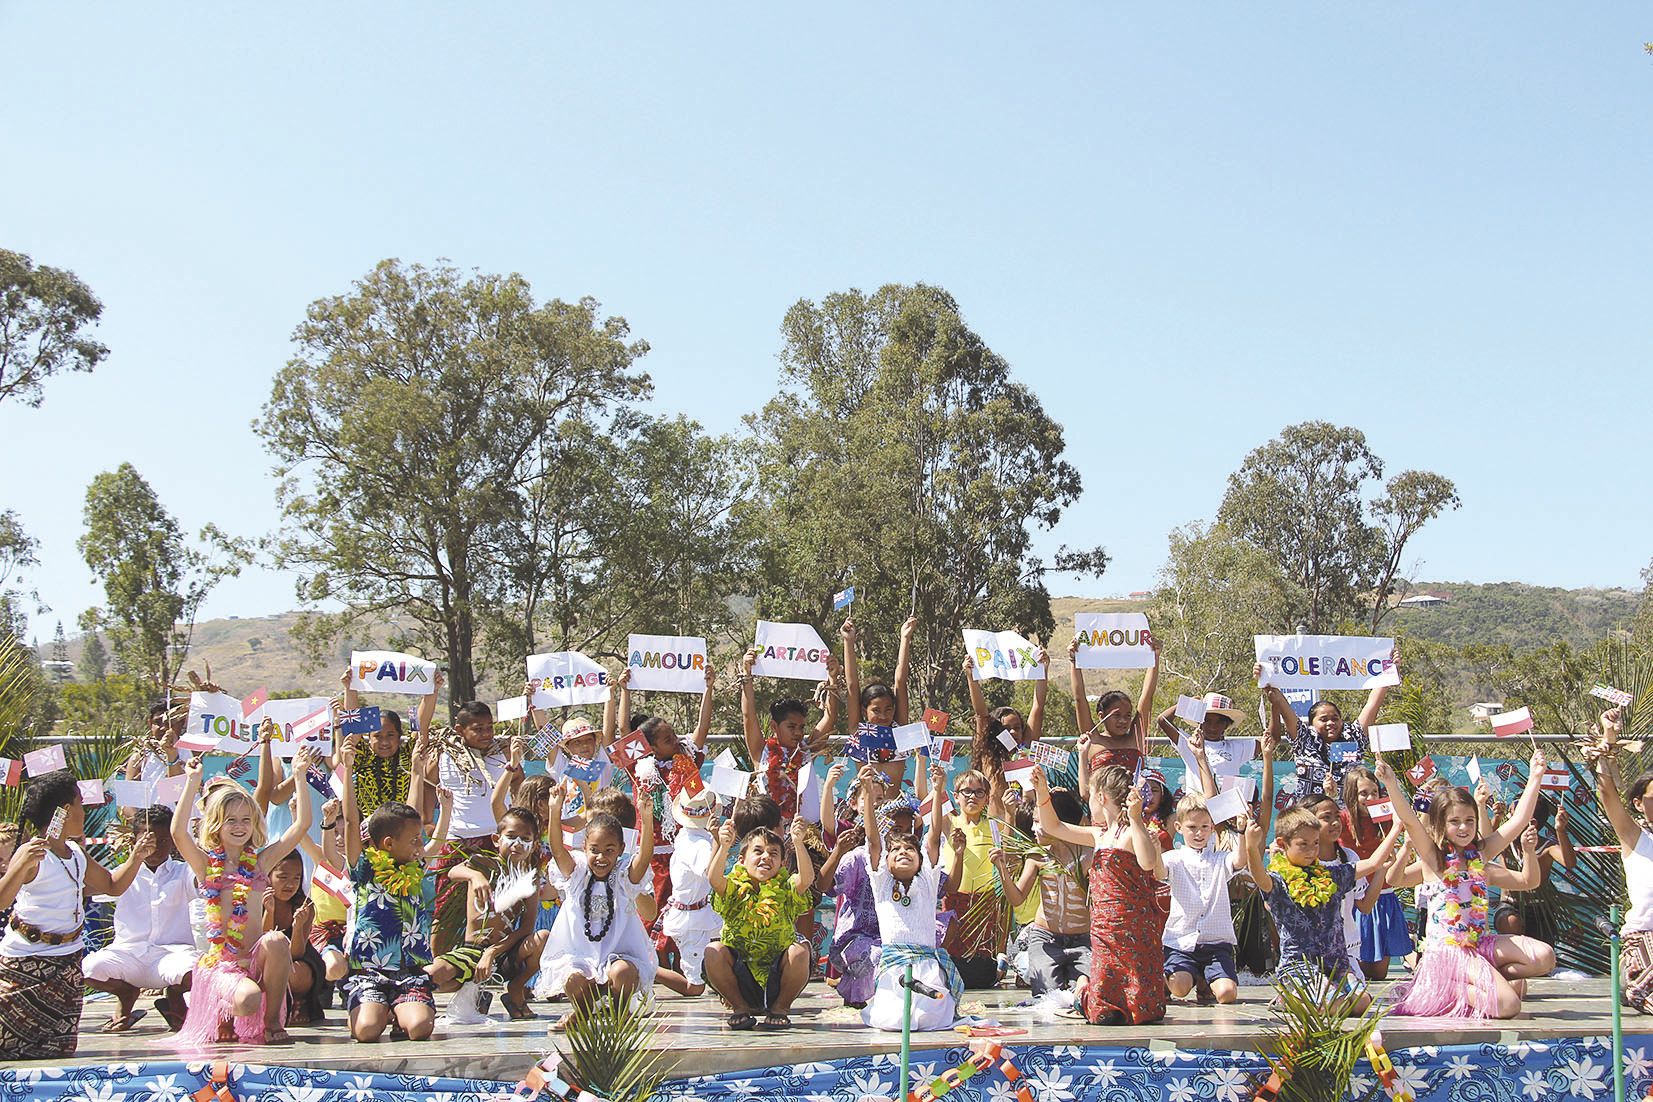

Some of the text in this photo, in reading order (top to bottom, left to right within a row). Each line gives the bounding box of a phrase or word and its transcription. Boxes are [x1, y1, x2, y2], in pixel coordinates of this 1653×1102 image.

[1078, 629, 1153, 647] AMOUR
[628, 650, 704, 671] AMOUR
[755, 644, 829, 664] PARTAGE
[975, 646, 1038, 670] PAIX
[358, 659, 428, 683] PAIX
[1267, 655, 1393, 677] TOLERANCE
[530, 671, 607, 691] PARTAGE
[200, 713, 331, 742] TOLEANE
